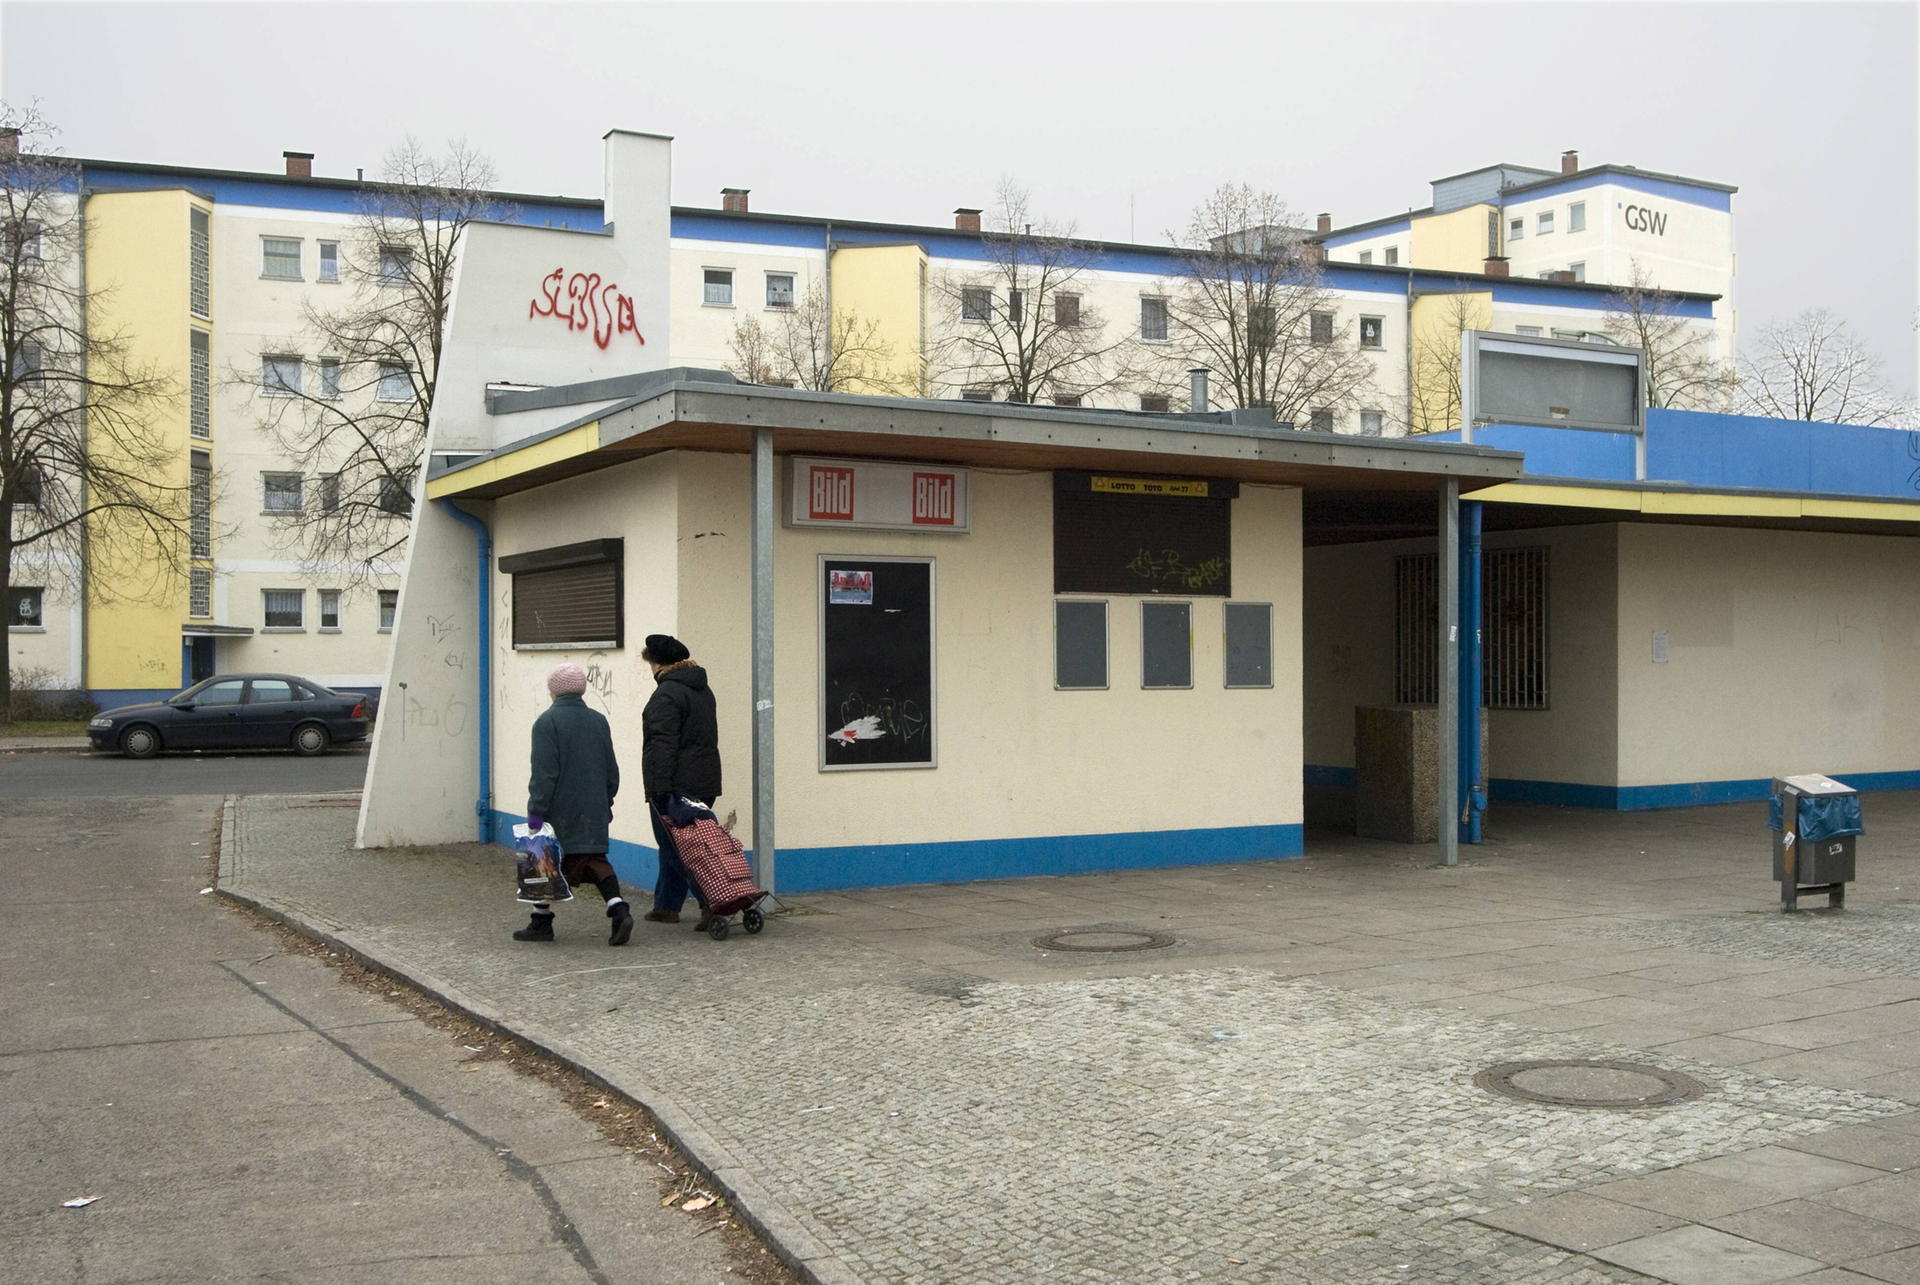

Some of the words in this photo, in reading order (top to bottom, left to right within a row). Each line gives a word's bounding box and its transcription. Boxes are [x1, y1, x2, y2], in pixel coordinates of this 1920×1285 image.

[1625, 204, 1667, 236] GSW
[813, 471, 850, 514] Bild
[916, 477, 952, 519] Bild
[1111, 482, 1136, 490] LOTTO
[1144, 484, 1162, 492] TOTO
